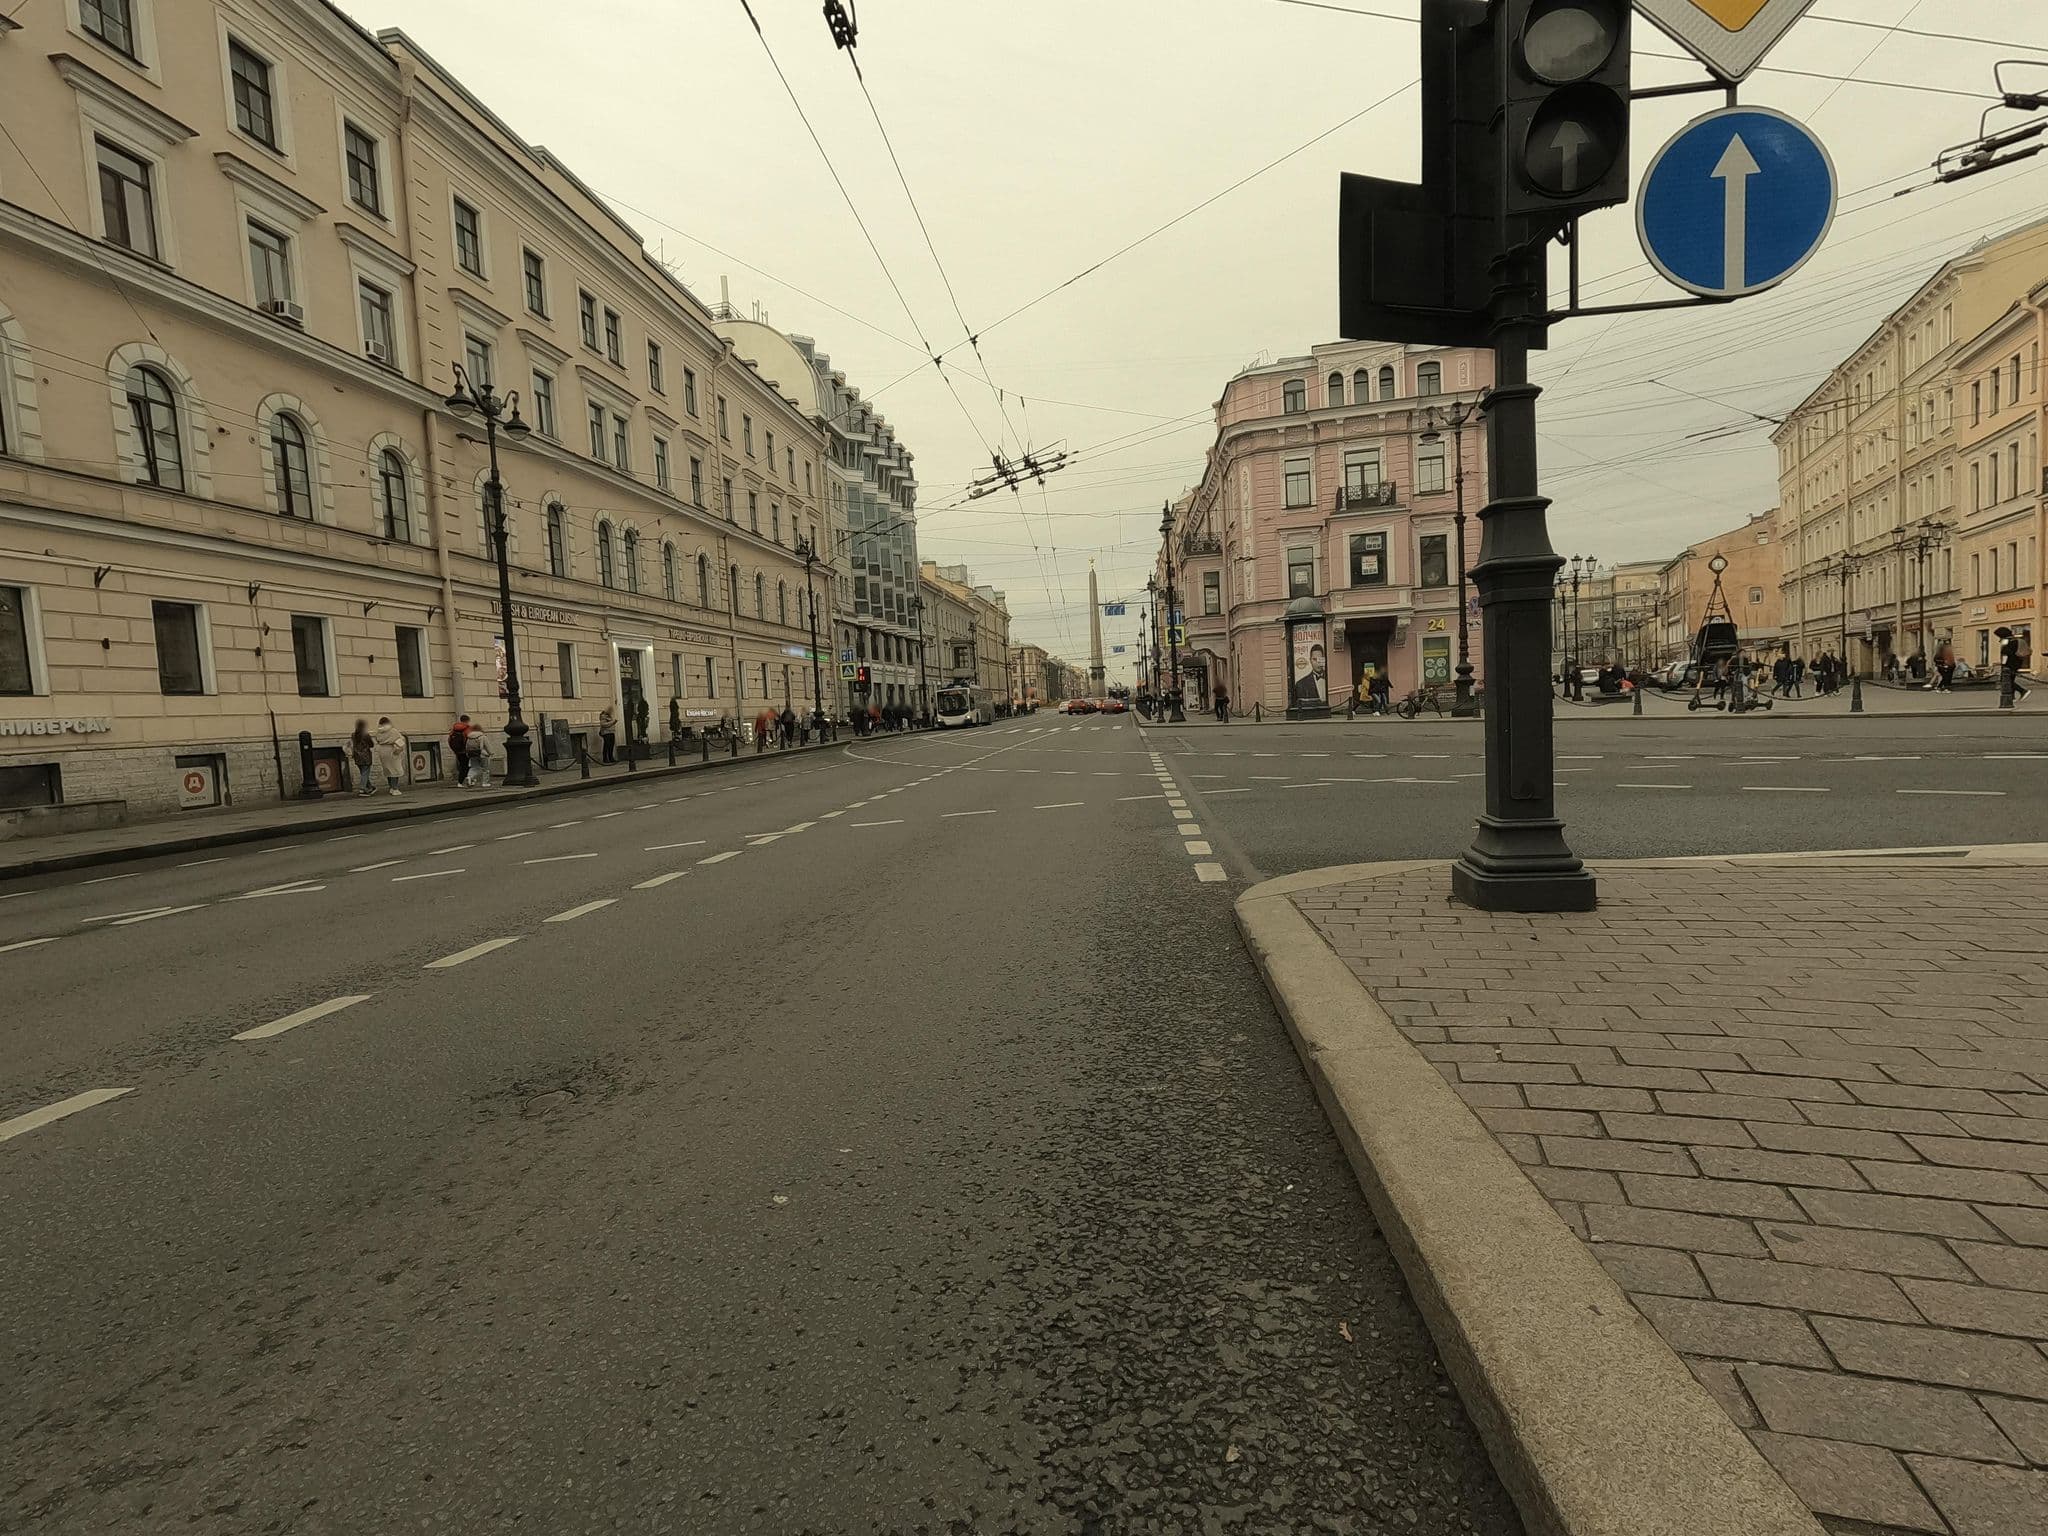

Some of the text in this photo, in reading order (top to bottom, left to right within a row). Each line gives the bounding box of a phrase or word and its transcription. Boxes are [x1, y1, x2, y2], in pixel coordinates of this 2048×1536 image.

[491, 601, 520, 617] TUSH
[529, 607, 558, 623] EUROPEAN
[1428, 618, 1447, 632] 24
